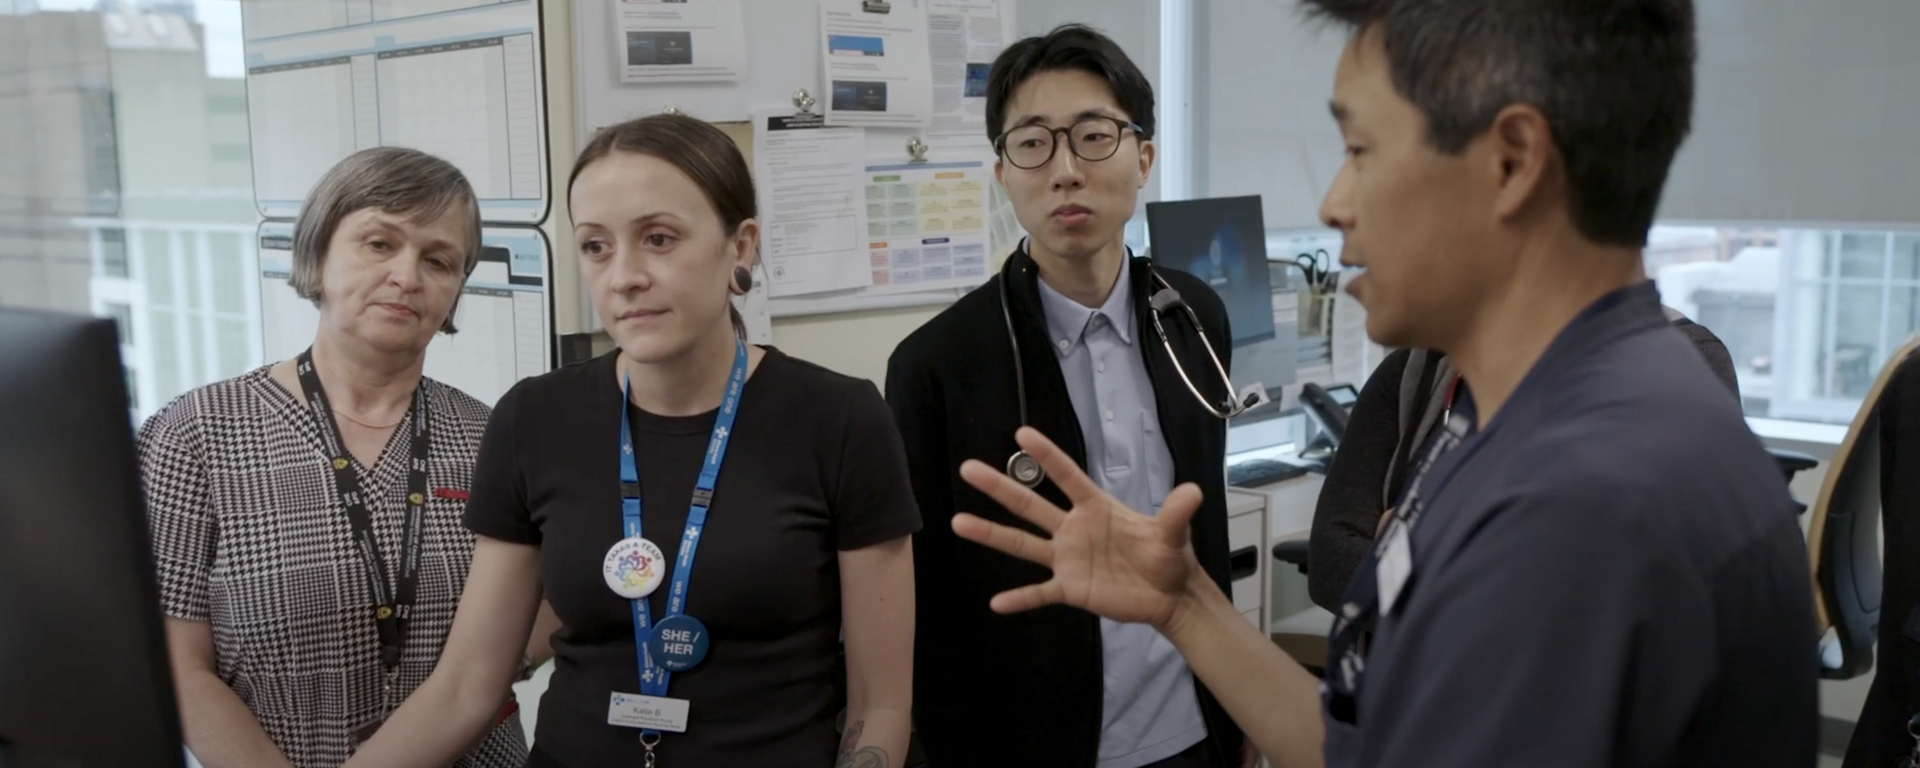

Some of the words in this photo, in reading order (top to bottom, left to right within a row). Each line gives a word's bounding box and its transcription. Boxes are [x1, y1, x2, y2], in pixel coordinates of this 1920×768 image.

[734, 368, 742, 380] we
[730, 381, 738, 396] are
[724, 397, 734, 414] one
[607, 543, 631, 562] TAKES
[641, 543, 662, 561] TEAM
[605, 564, 612, 573] IT
[674, 581, 682, 595] we
[671, 596, 680, 612] are
[639, 614, 646, 627] we
[661, 628, 691, 643] SHE
[692, 631, 701, 643] /
[663, 642, 694, 656] HER
[633, 707, 653, 715] Katie
